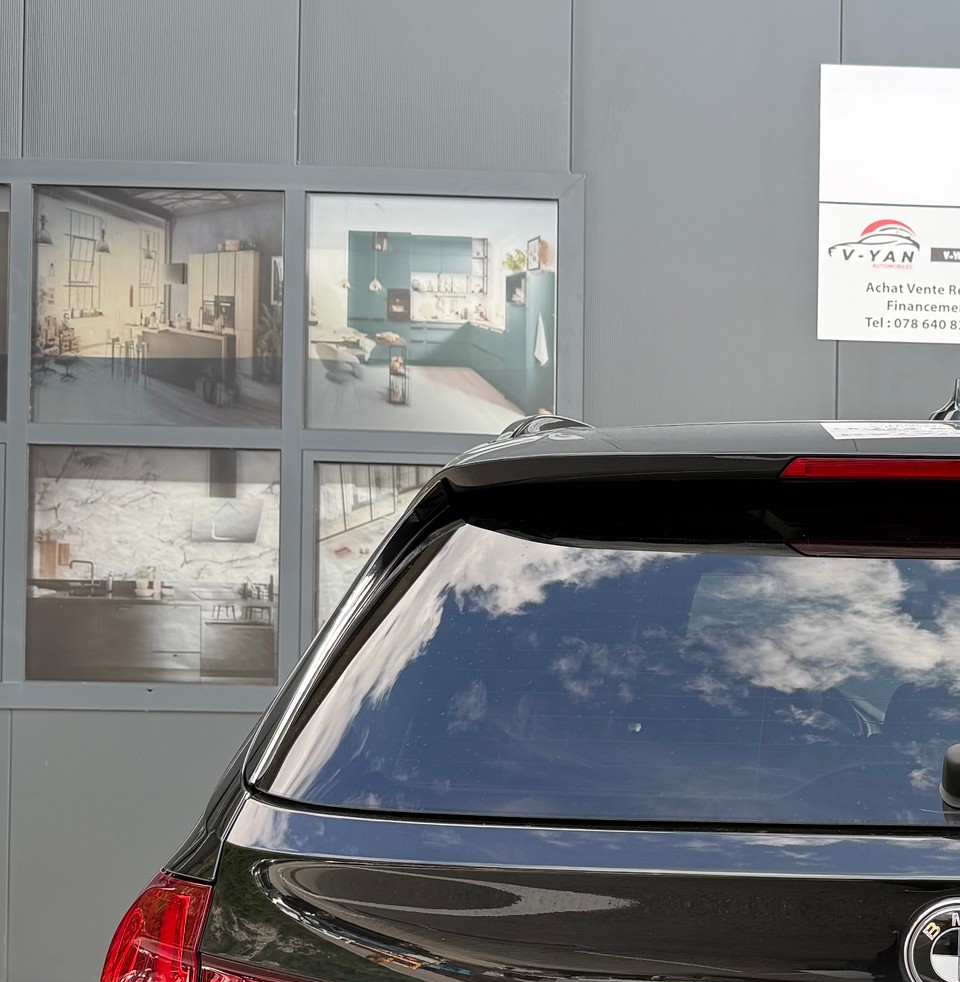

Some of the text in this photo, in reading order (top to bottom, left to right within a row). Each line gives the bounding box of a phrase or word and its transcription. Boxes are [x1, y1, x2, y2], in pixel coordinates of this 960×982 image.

[842, 248, 915, 263] V-YAN
[865, 282, 904, 294] Achat
[907, 283, 945, 295] Vente
[894, 318, 919, 329] 078
[922, 319, 946, 330] 640
